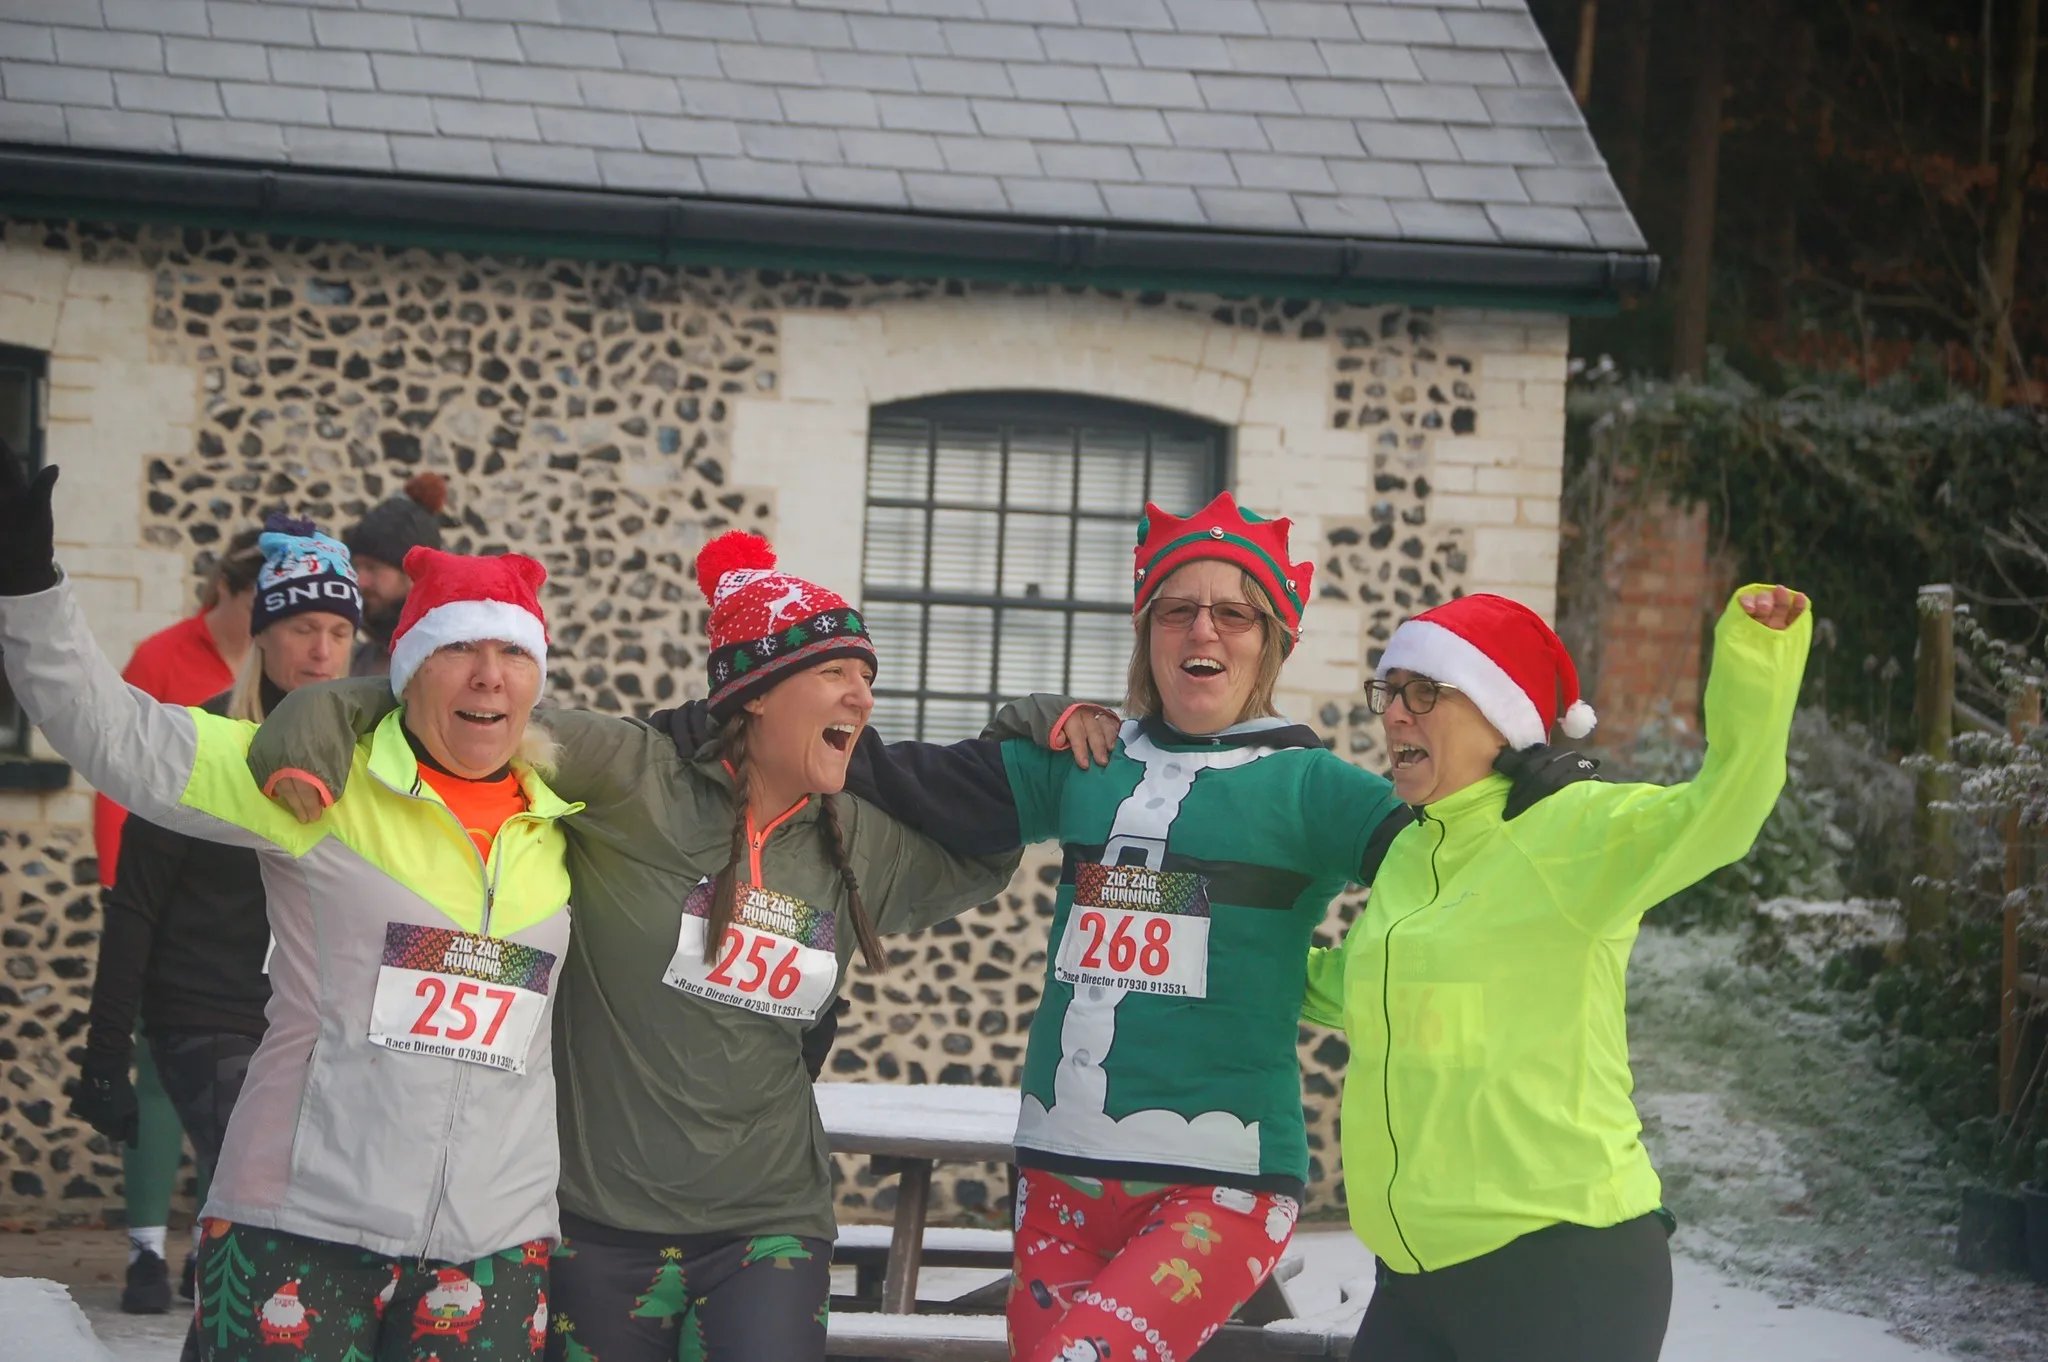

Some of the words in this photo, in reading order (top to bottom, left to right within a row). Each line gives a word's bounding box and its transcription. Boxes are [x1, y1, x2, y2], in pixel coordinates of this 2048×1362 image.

[1106, 871, 1127, 887] ZIG
[1131, 874, 1157, 890] ZAG
[747, 890, 768, 908] ZIG
[770, 897, 795, 917] ZAG
[1101, 886, 1161, 906] RUNNING
[742, 904, 797, 933] RUNNING
[450, 936, 473, 953] ZIG
[476, 940, 501, 961] ZAG
[1079, 911, 1172, 976] 268
[443, 951, 502, 977] RUNNING
[705, 928, 802, 1000] 256
[678, 978, 703, 995] Race
[705, 988, 743, 1006] Director
[744, 999, 770, 1012] 07930
[1081, 973, 1115, 987] Director
[1117, 977, 1148, 991] 07930
[1150, 981, 1187, 995] 913531
[409, 977, 516, 1046] 257
[385, 1037, 411, 1050] Race
[413, 1040, 456, 1057] Director
[458, 1047, 488, 1062] 07930
